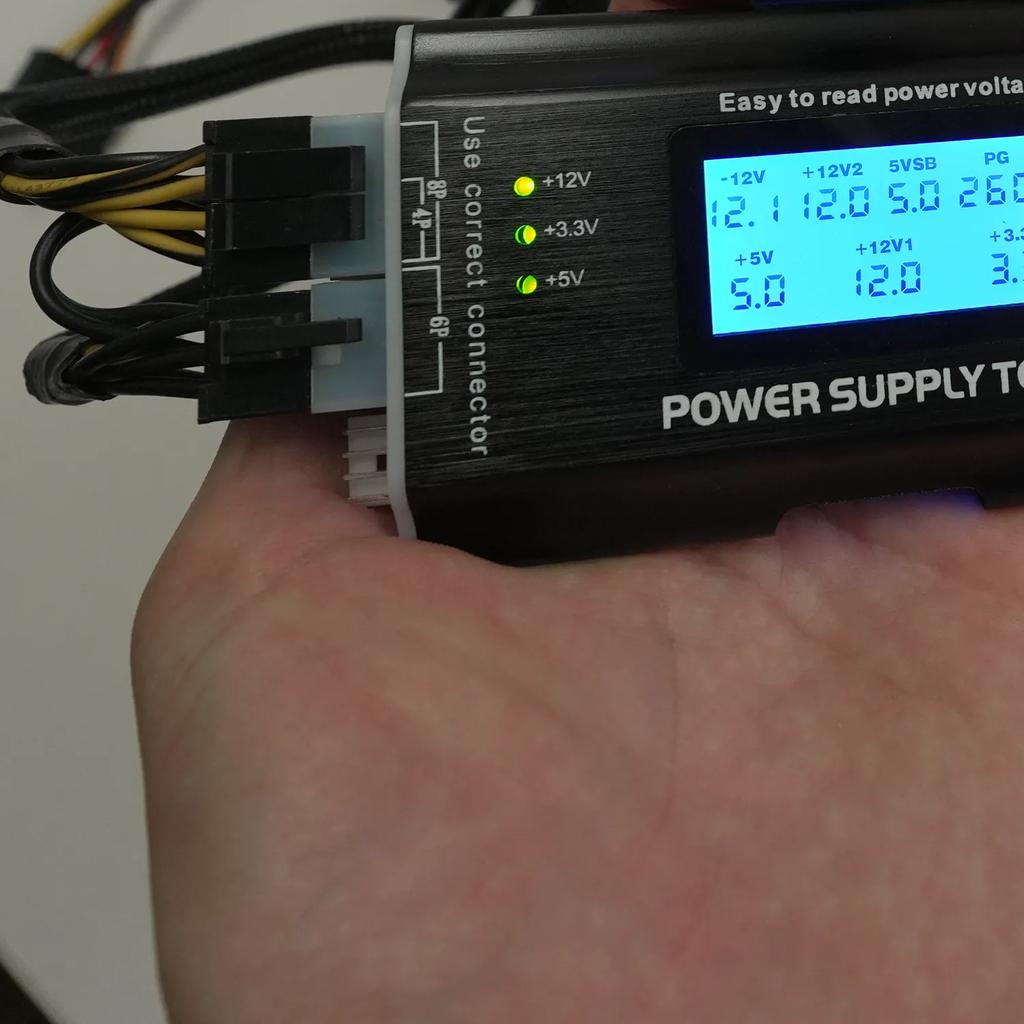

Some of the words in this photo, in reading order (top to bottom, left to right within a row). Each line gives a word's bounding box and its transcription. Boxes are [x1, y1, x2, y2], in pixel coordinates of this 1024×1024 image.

[720, 93, 782, 114] Easy
[789, 89, 814, 107] to
[822, 84, 876, 105] read
[884, 83, 959, 106] power
[463, 117, 485, 168] Use
[542, 171, 591, 188] +12V
[721, 170, 765, 185] -12V
[803, 163, 863, 178] +12V2
[890, 157, 936, 172] 5VSB
[984, 151, 1009, 165] PG
[427, 180, 447, 198] 8P
[804, 186, 869, 220] 12.0
[889, 180, 939, 214] 5.0
[412, 208, 432, 228] 4P
[544, 219, 599, 237] +3.3V
[465, 184, 488, 288] correct
[736, 250, 773, 265] +5V
[856, 239, 912, 255] +12V1
[546, 269, 584, 287] +5V
[731, 275, 785, 310] 5.0
[856, 262, 920, 297] 12.0
[430, 317, 449, 337] 6P
[468, 305, 491, 455] connector
[663, 382, 820, 429] POWER
[829, 364, 985, 411] SUPPLY
